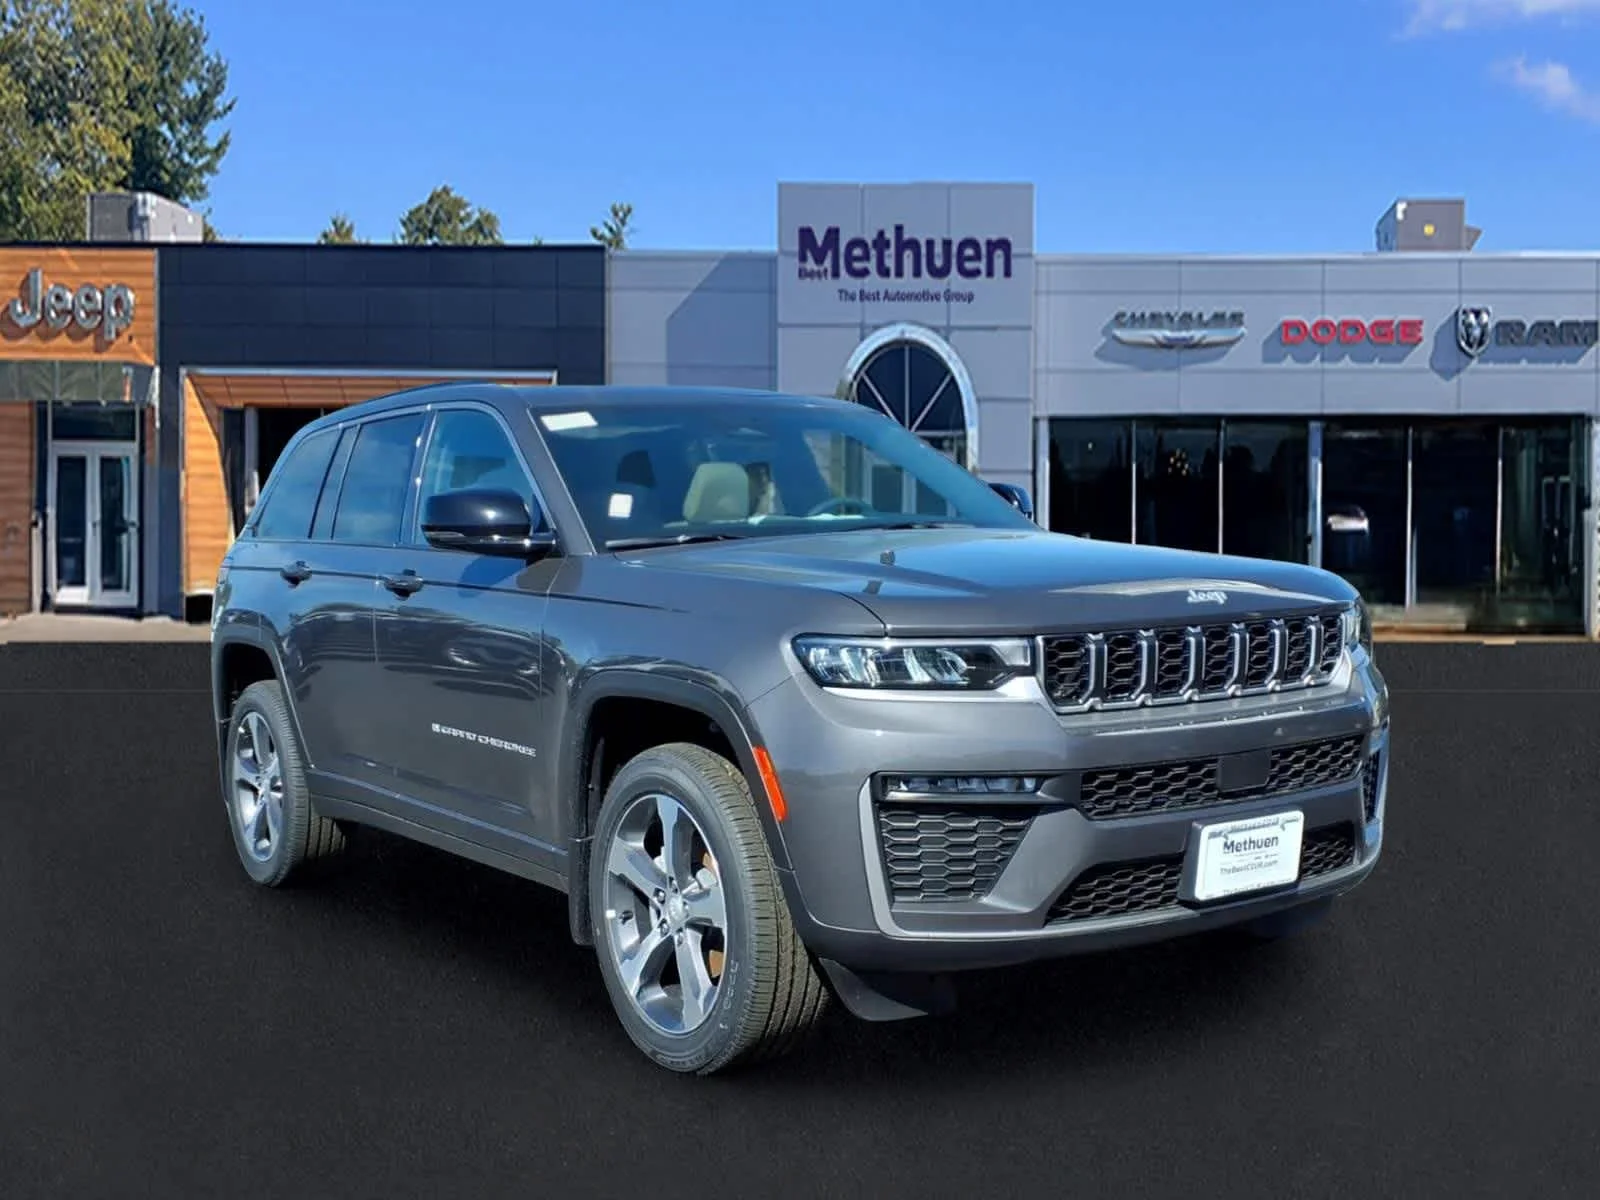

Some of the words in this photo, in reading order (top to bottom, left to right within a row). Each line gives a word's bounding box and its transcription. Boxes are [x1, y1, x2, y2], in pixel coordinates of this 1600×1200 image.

[798, 224, 1012, 279] Methuen
[9, 267, 135, 340] Jeep
[838, 288, 857, 301] The
[859, 288, 880, 302] Best
[883, 288, 941, 302] Automotive
[943, 288, 974, 304] Group
[1282, 319, 1424, 344] DODGE
[1495, 320, 1599, 347] RAM
[1187, 589, 1228, 605] Jeep
[1223, 835, 1279, 853] Methuen
